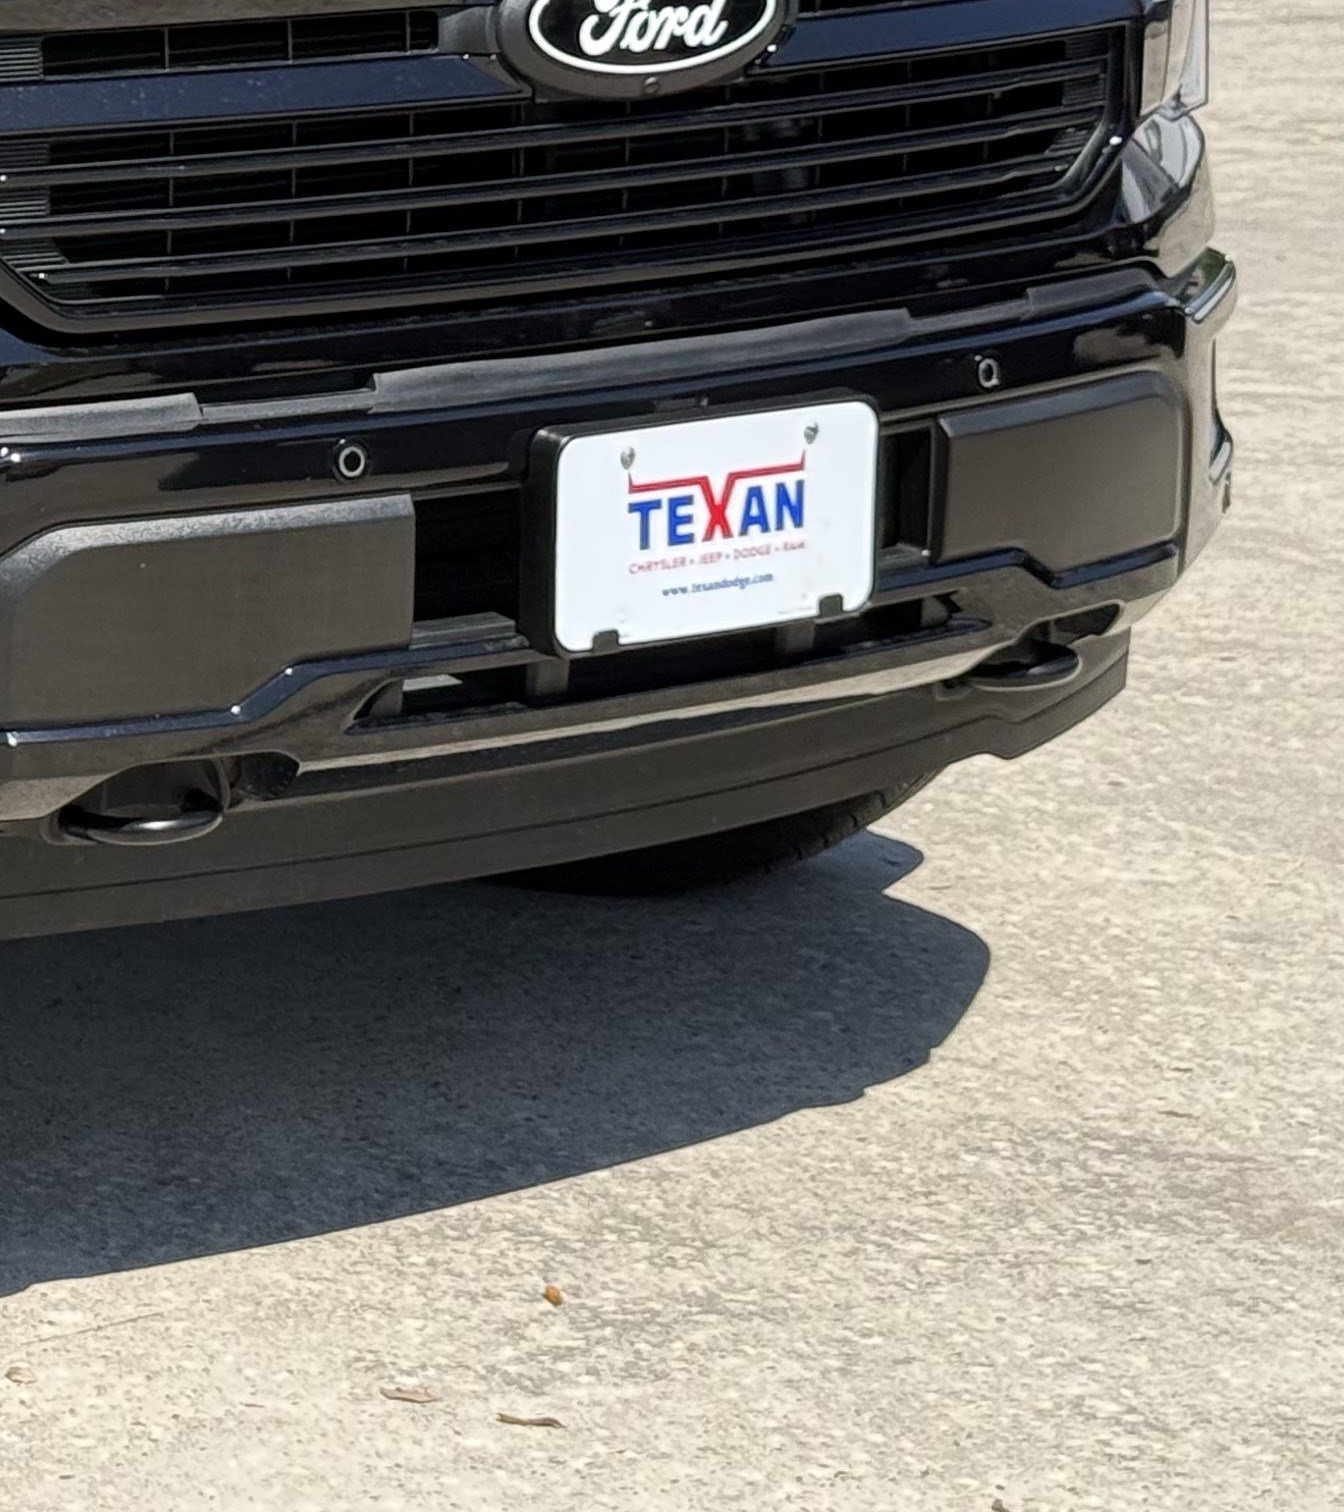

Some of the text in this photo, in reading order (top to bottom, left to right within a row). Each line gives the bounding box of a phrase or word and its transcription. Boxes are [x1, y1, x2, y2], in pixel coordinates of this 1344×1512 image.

[627, 472, 806, 551] TEXAN
[628, 540, 806, 575] CHRYSLER JEEP DODGE RAM
